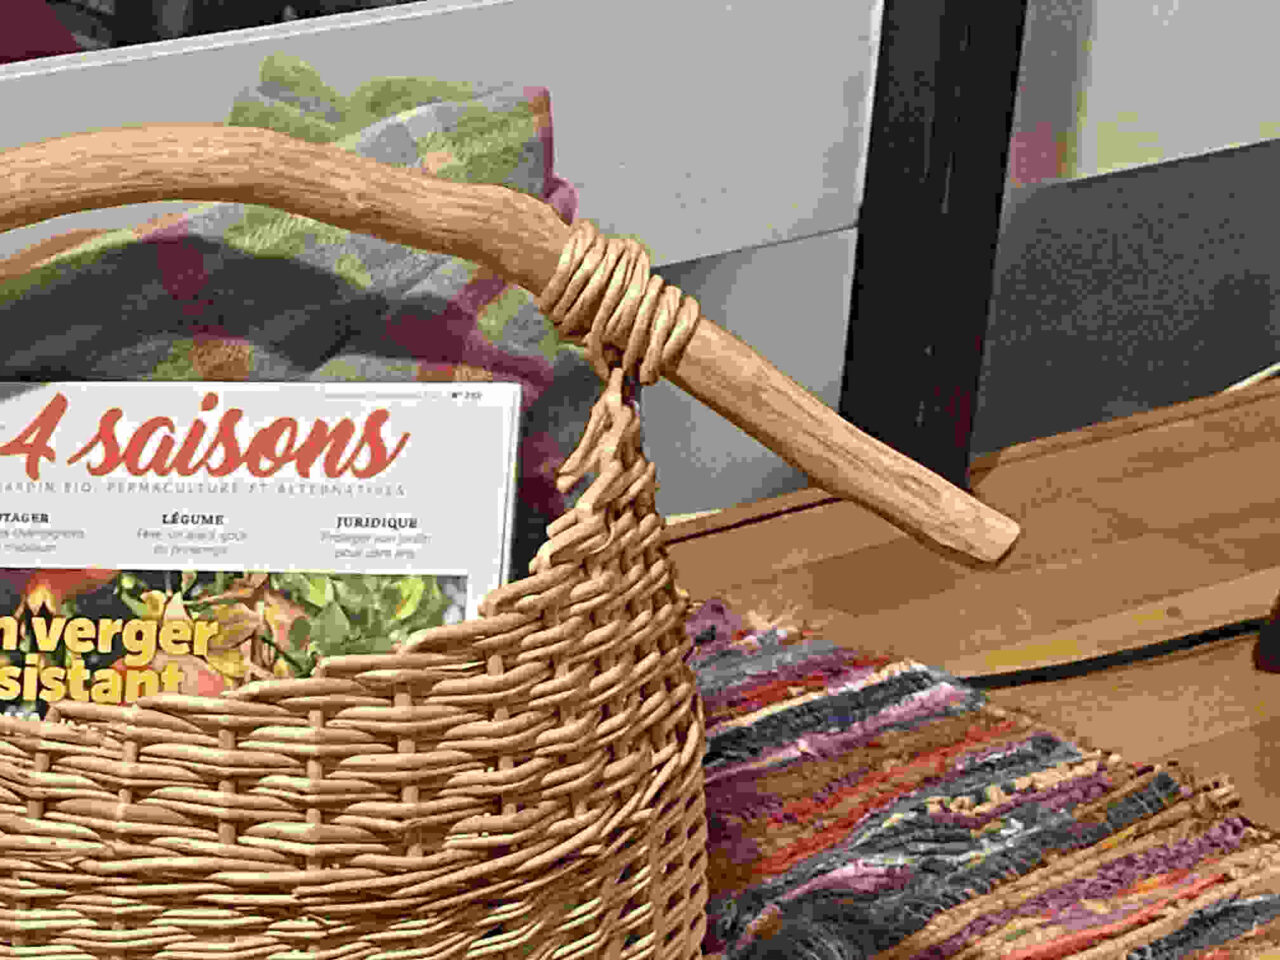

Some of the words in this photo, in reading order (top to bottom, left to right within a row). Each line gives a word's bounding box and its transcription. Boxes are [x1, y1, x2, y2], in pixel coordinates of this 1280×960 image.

[0, 392, 68, 481] 4
[66, 391, 411, 479] saisons
[107, 482, 238, 494] PERMACULTURE
[162, 511, 225, 526] LÉGUME
[336, 516, 418, 530] JURIDIQUE
[31, 615, 218, 667] verger
